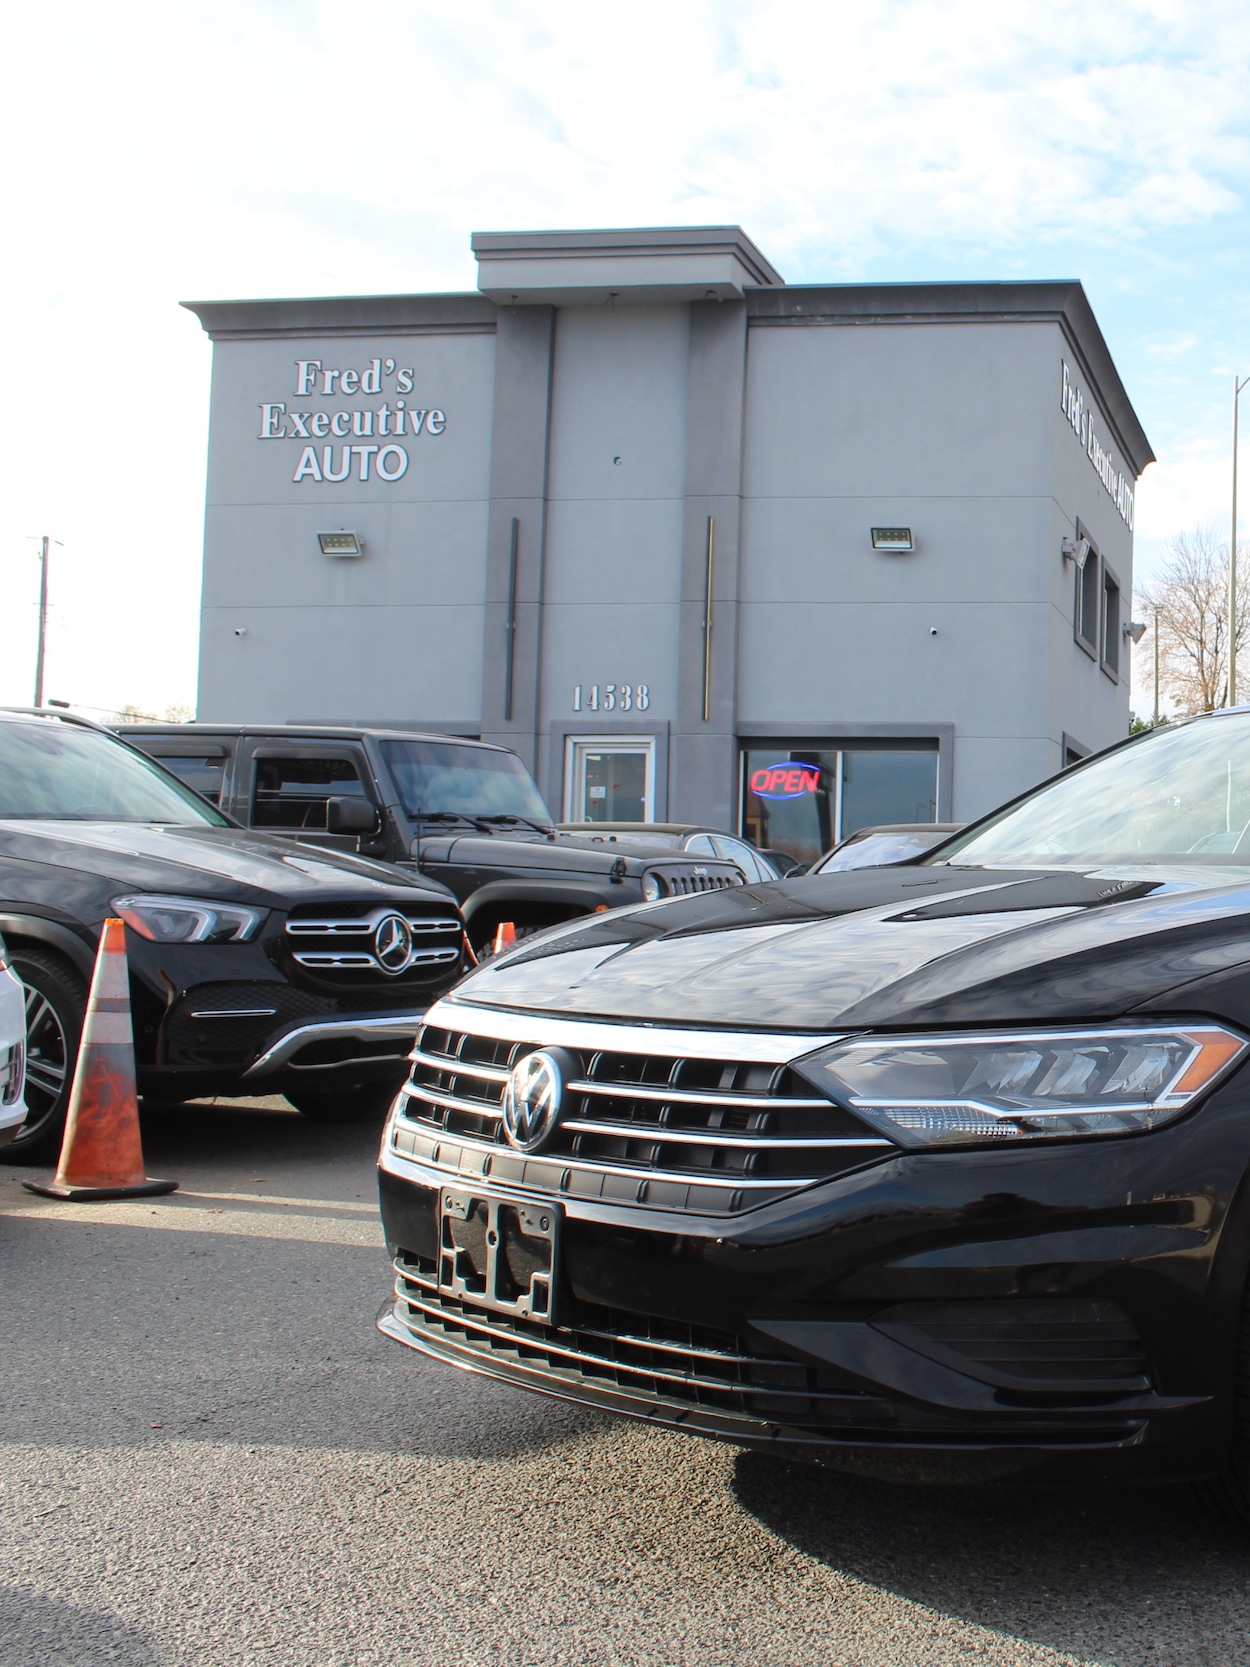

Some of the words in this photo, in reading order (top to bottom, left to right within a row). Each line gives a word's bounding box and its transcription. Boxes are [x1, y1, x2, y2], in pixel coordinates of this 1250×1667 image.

[293, 358, 414, 396] Fred's
[257, 400, 446, 439] Executive
[292, 444, 409, 482] AUTO
[572, 684, 650, 711] 14538
[751, 769, 820, 793] OPEN
